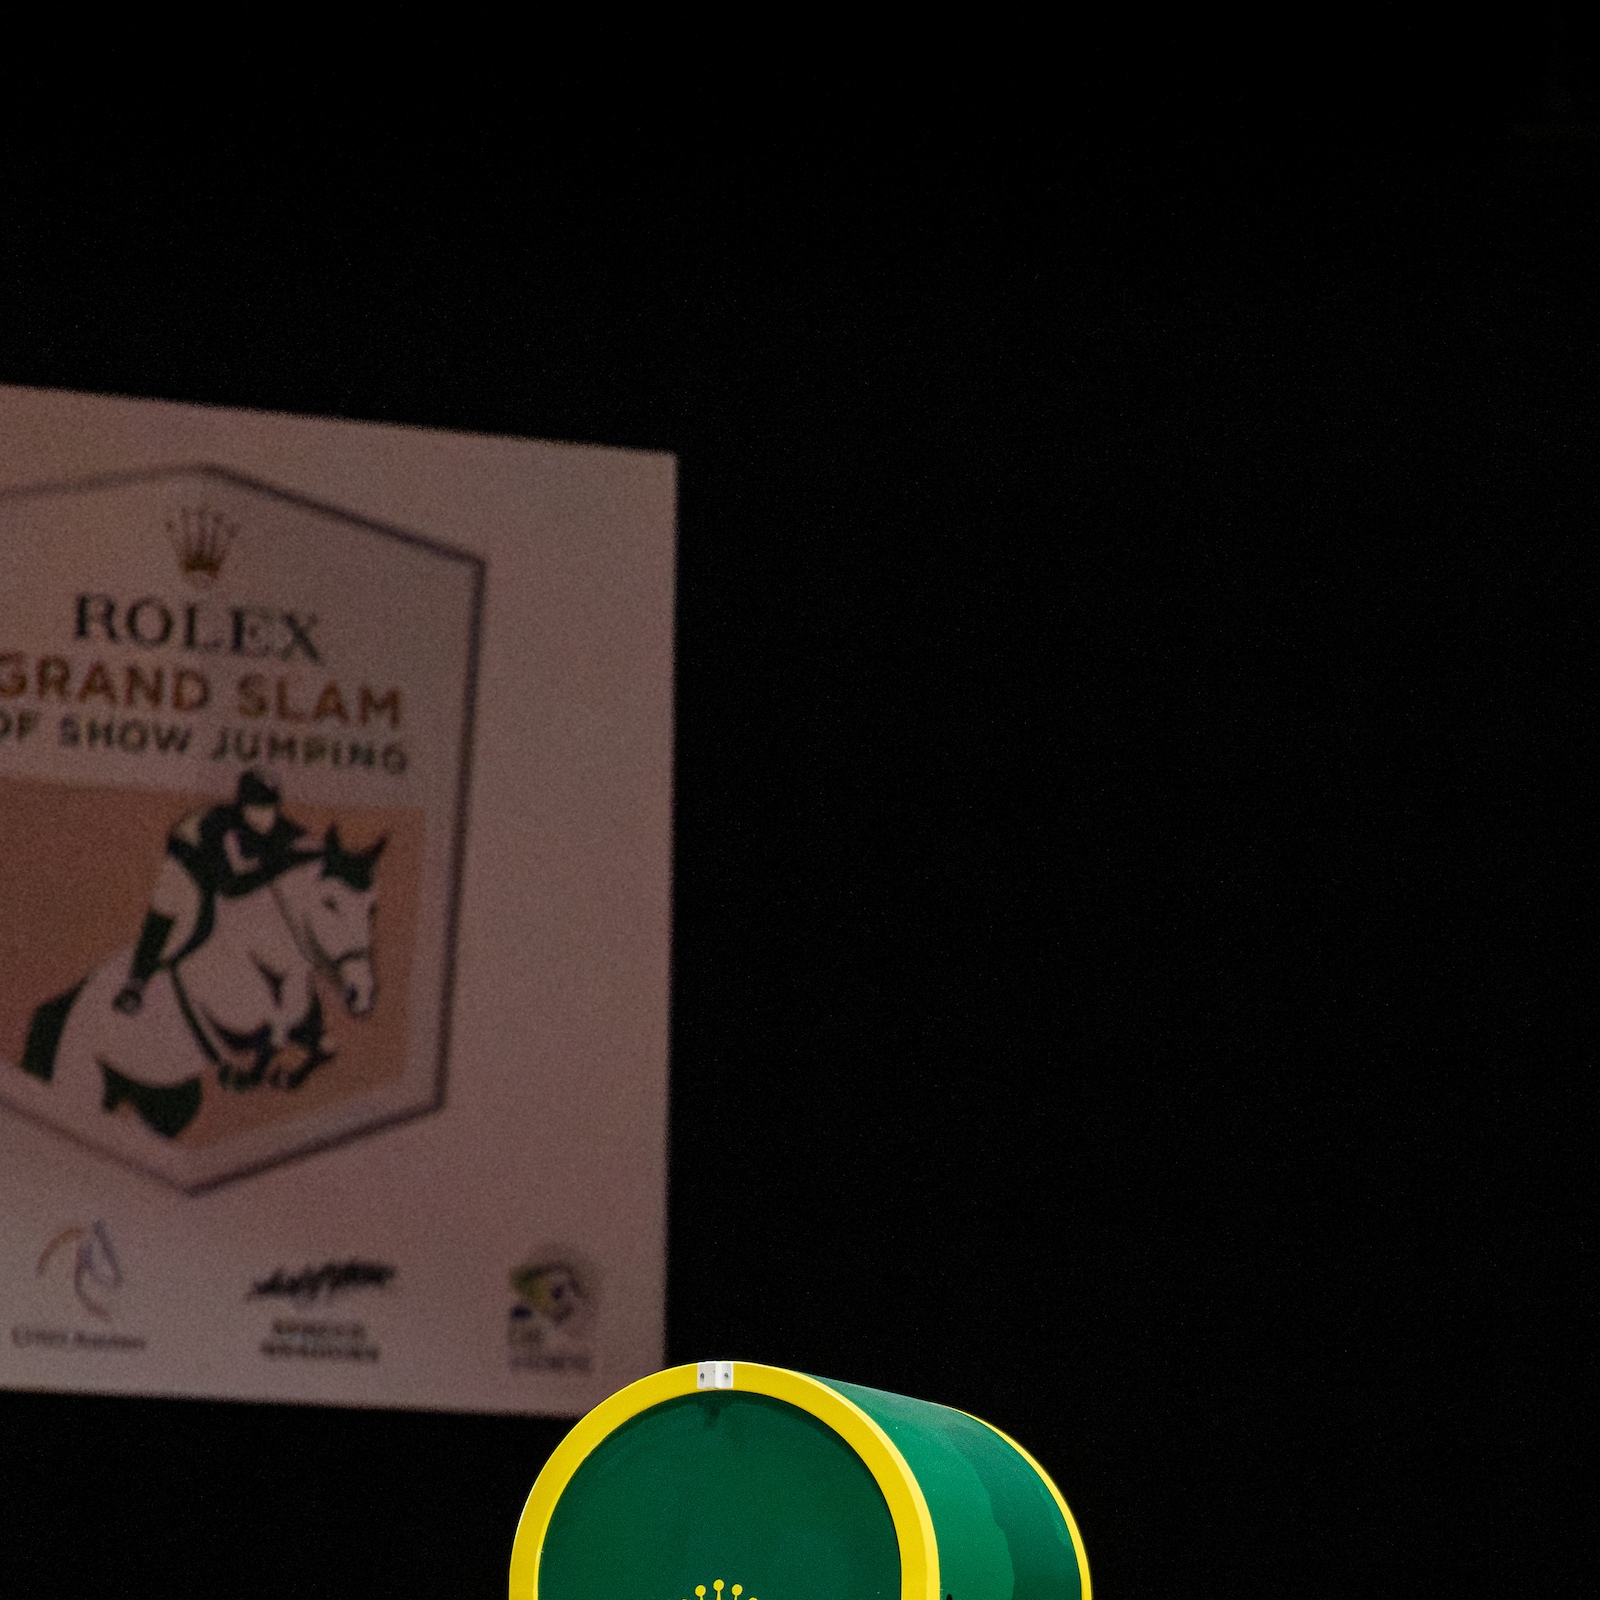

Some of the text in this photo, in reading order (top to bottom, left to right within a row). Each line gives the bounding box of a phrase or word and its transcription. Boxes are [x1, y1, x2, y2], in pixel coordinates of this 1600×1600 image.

[74, 593, 323, 664] ROLEX
[0, 650, 401, 728] GRAND SLAM
[59, 714, 191, 753] SHOW
[210, 727, 408, 775] JUMPING
